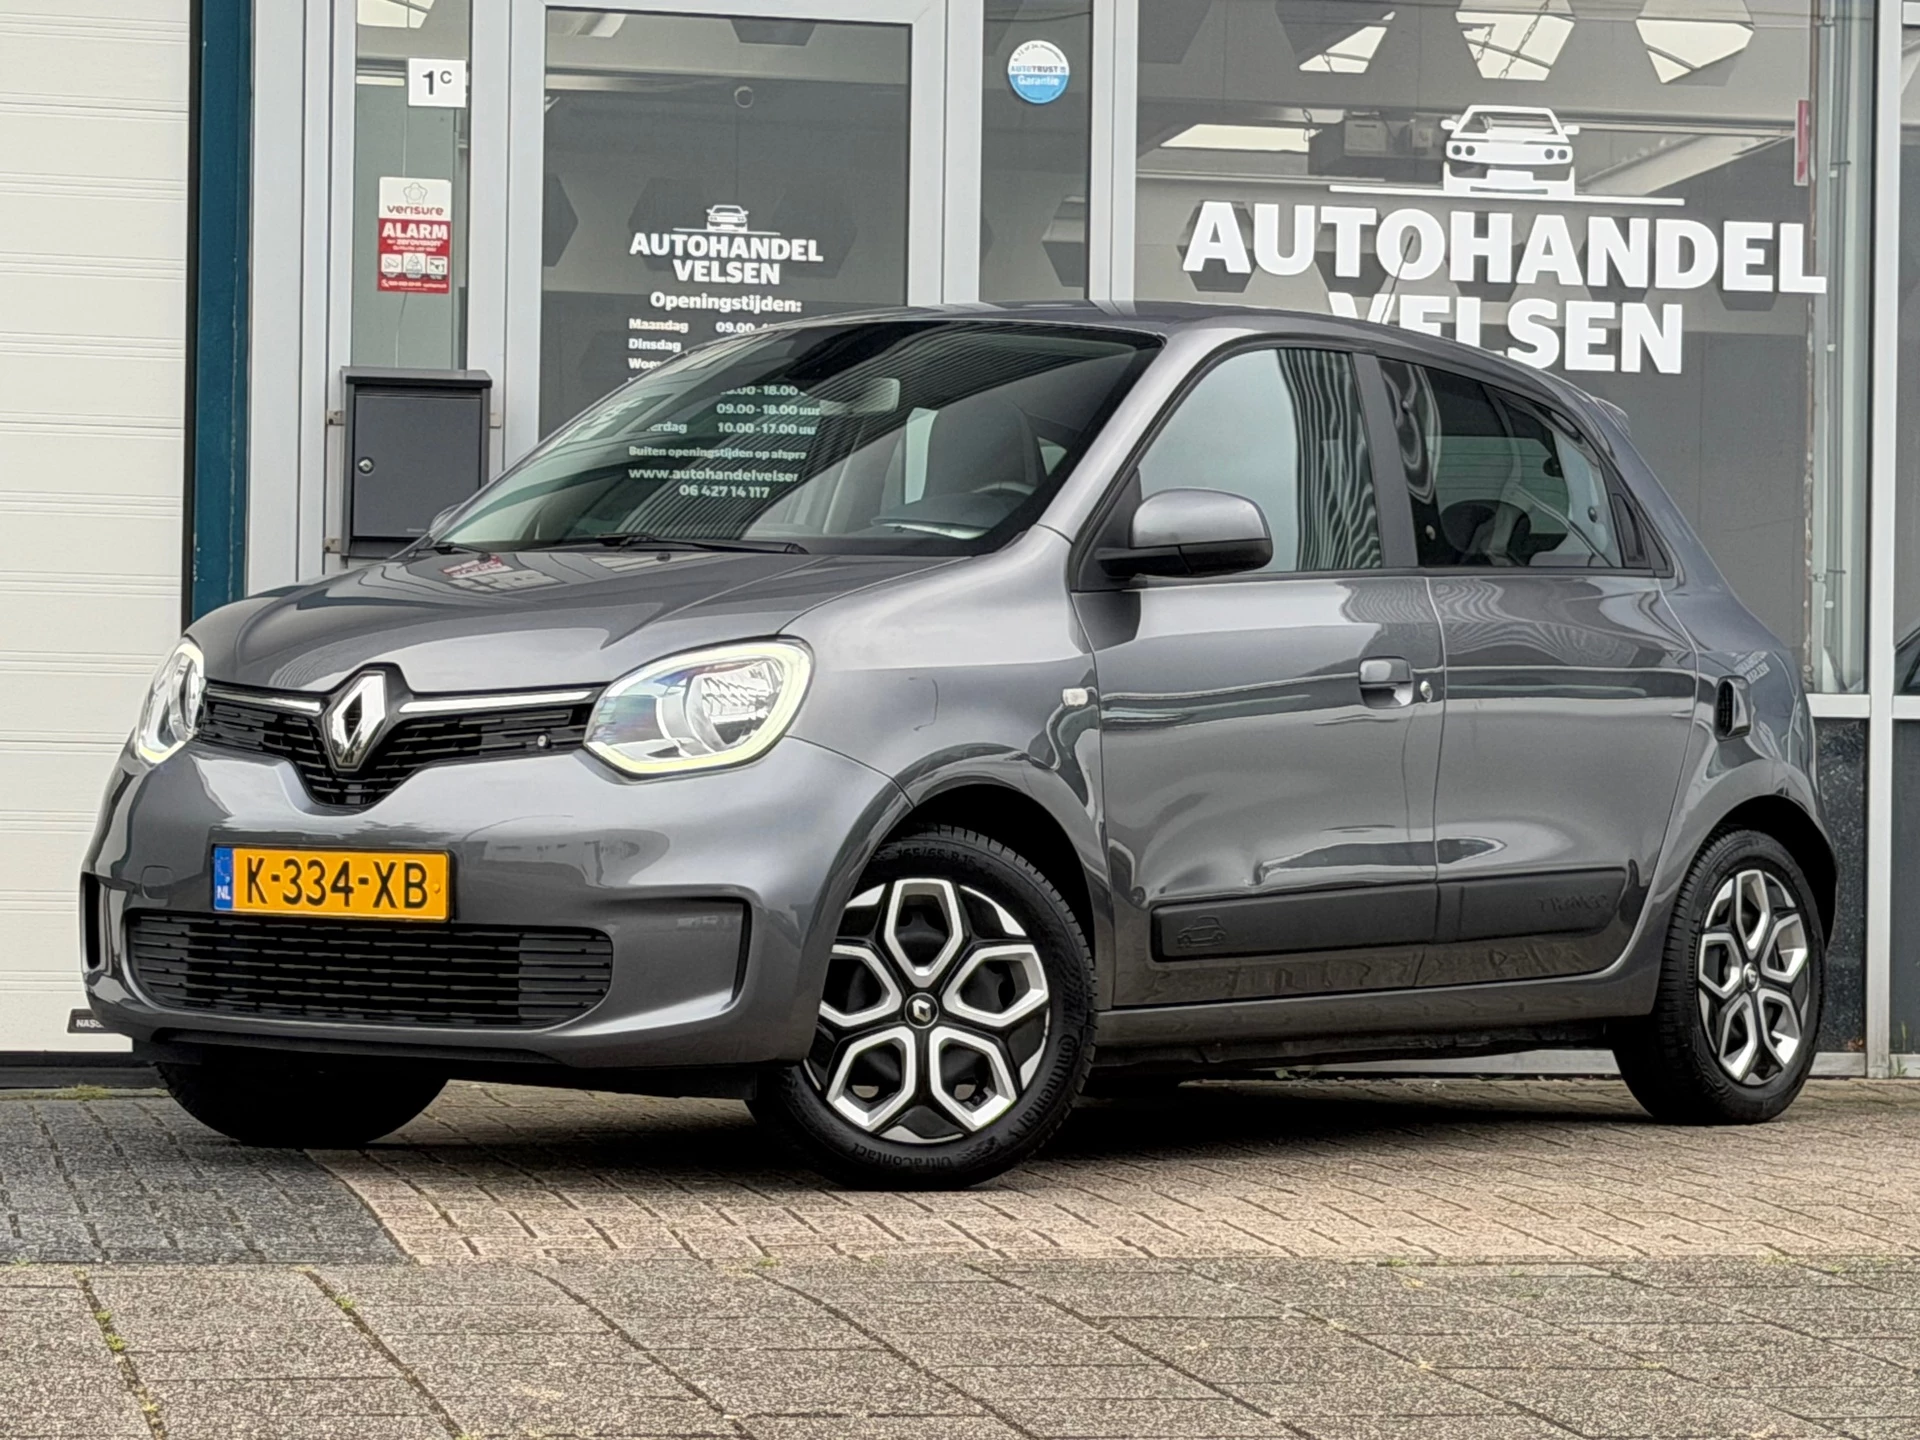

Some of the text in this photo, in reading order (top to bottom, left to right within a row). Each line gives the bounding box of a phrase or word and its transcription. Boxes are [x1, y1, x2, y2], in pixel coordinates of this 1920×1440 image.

[387, 205, 444, 216] verisure
[382, 222, 448, 240] ALARM
[629, 232, 824, 262] AUTOHANDEL
[1181, 201, 1827, 294] AUTOHANDEL
[673, 259, 780, 285] VELSEN
[650, 291, 802, 314] Openingstijden:
[628, 318, 689, 333] Maandag
[628, 338, 682, 353] Dinsdag
[646, 421, 687, 434] erdag
[629, 446, 667, 456] Buiten
[668, 447, 753, 460] openingstijden
[755, 450, 770, 460] op
[679, 484, 770, 498] 06 427 14 117
[217, 857, 428, 909] NL K-334-XB
